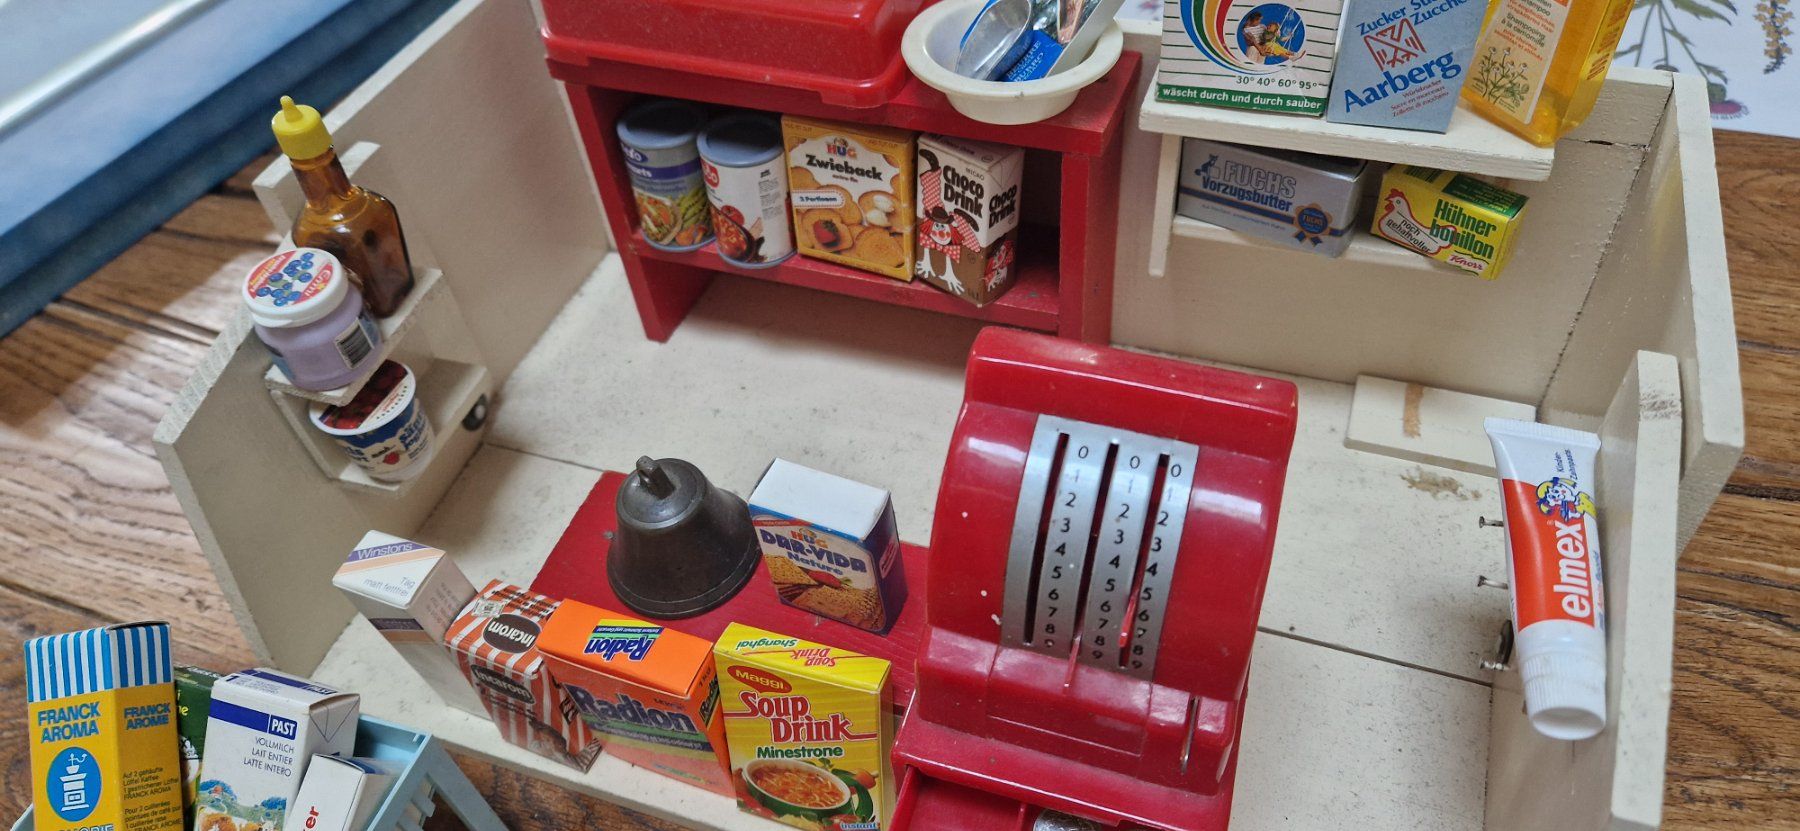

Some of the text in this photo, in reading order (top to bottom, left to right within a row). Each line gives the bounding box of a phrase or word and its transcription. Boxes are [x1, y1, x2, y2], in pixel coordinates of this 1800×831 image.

[1356, 7, 1407, 36] Zucker
[1236, 75, 1318, 90] 30° 40° 60° 95°
[1344, 52, 1462, 112] Aarberg
[1162, 87, 1322, 110] wäscht durch und durch sauber
[806, 154, 883, 181] Zwieback
[943, 165, 985, 199] Choco
[1223, 160, 1297, 199] FUCHS
[944, 183, 983, 219] Drink
[989, 184, 1018, 212] Choco
[1202, 176, 1293, 212] Vorzugsbutter
[989, 200, 1017, 228] Drink
[1434, 198, 1497, 238] Hühner
[1386, 218, 1431, 253] gehaltvoller
[1400, 219, 1421, 236] noch
[1430, 219, 1495, 260] bouillon
[1449, 255, 1485, 270] Knorr
[1078, 446, 1089, 459] 0
[1129, 456, 1140, 469] 0
[1171, 464, 1182, 478] 0
[1066, 492, 1077, 508] 2
[1118, 503, 1130, 518] 2
[1157, 511, 1169, 527] 2
[1060, 518, 1071, 533] 3
[1114, 529, 1124, 544] 3
[1151, 537, 1162, 552] 3
[357, 542, 413, 560] Winstons
[1055, 543, 1067, 556] 4
[787, 551, 843, 576] Nature
[1108, 555, 1120, 568] 4
[1146, 562, 1158, 577] 4
[1553, 520, 1592, 619] elmex
[1051, 566, 1062, 579] 5
[1104, 578, 1115, 592] 5
[1142, 586, 1153, 601] 5
[1048, 588, 1059, 600] 6
[1048, 606, 1058, 618] 7
[1100, 601, 1111, 613] 6
[1138, 608, 1149, 622] 6
[1045, 623, 1055, 634] 8
[1099, 618, 1109, 630] 7
[488, 620, 536, 648] Incarom
[1094, 634, 1105, 646] 8
[584, 634, 657, 661] Radion
[736, 638, 800, 650] Shanghai
[1133, 644, 1143, 656] 8
[790, 648, 831, 659] Drink
[804, 656, 837, 667] Soup
[476, 669, 532, 701] Incarom
[735, 668, 785, 690] Maggi
[37, 702, 101, 726] FRANCK
[124, 703, 171, 720] FRANCK
[562, 683, 698, 733] Radion
[739, 691, 811, 721] Soup
[41, 719, 99, 744] AROMA
[126, 715, 170, 731] AROME
[271, 718, 296, 736] PAST
[770, 713, 854, 744] Drink
[255, 736, 295, 754] VOLLMILCH
[756, 745, 844, 759] Minestrone
[251, 747, 293, 765] LAIT ENTIER
[243, 757, 292, 777] LATTE INTERO
